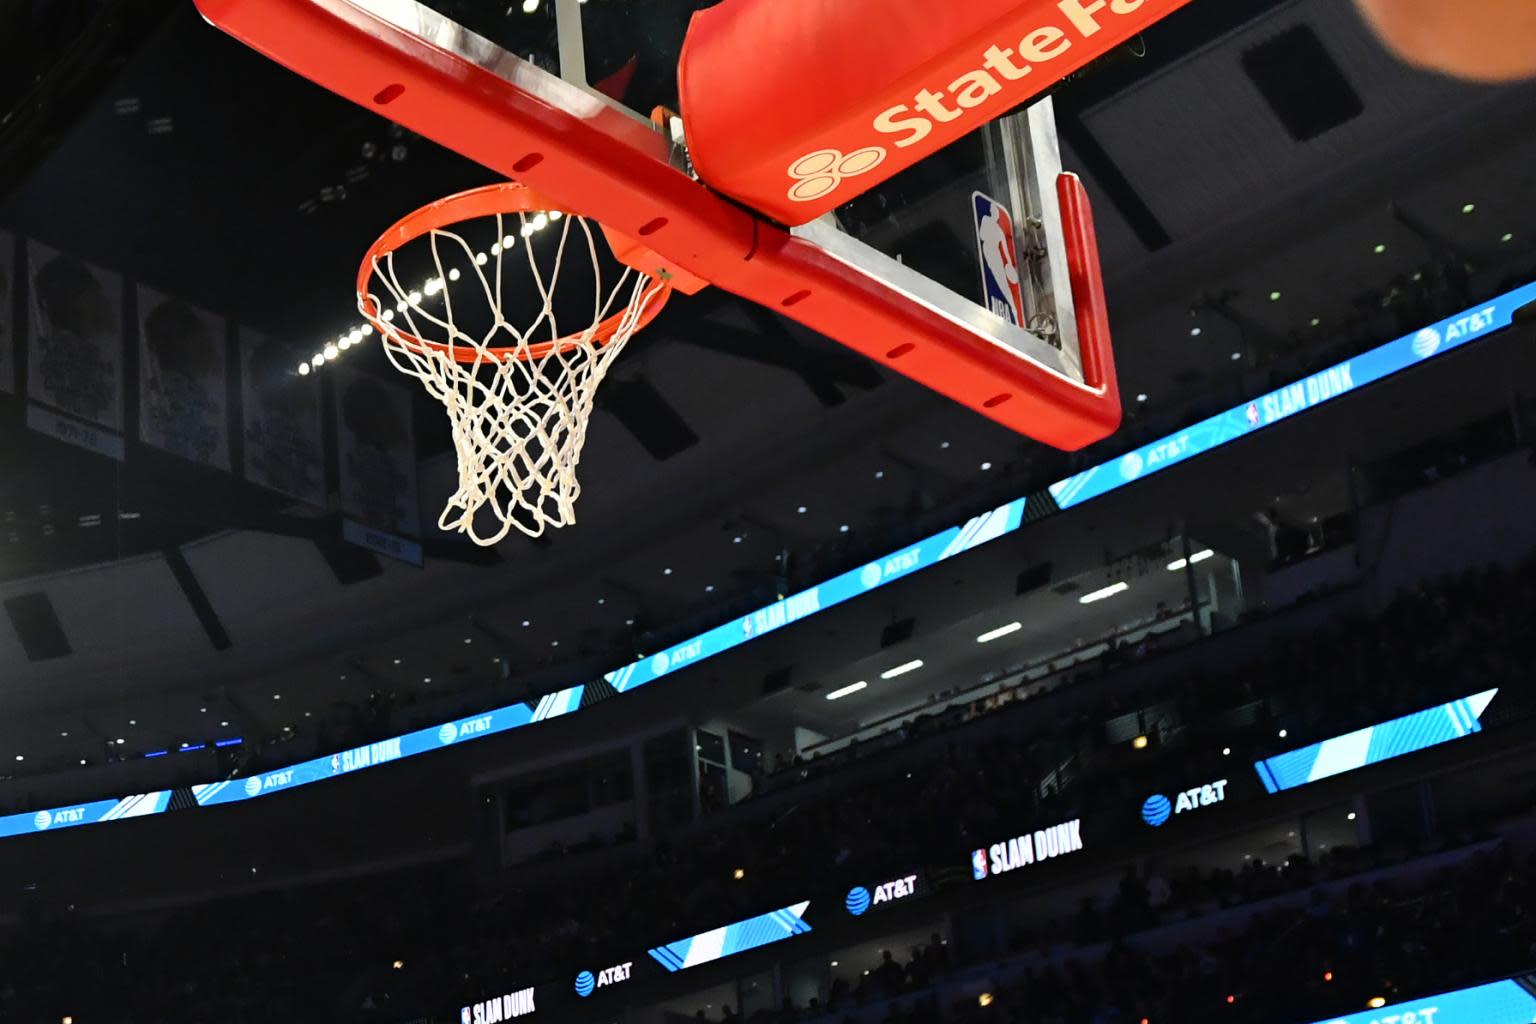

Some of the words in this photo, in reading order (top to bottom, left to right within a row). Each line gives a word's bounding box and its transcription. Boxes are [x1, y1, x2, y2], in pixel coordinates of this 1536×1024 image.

[1445, 307, 1495, 342] AT&T
[1264, 382, 1306, 422] SLAM
[1309, 363, 1353, 404] DUNK
[1147, 435, 1189, 466] AT&T
[884, 548, 920, 576] AT&T
[671, 641, 702, 665] AT&T
[460, 716, 492, 734] AT&T
[264, 771, 294, 788] AT&T
[1175, 780, 1227, 813] AT&T
[54, 809, 85, 824] AT&T
[990, 832, 1033, 874] SLAM
[1034, 820, 1082, 861] DUNK
[873, 875, 917, 904] AT&T
[598, 963, 632, 987] AT&T
[504, 988, 535, 1020] DUNK
